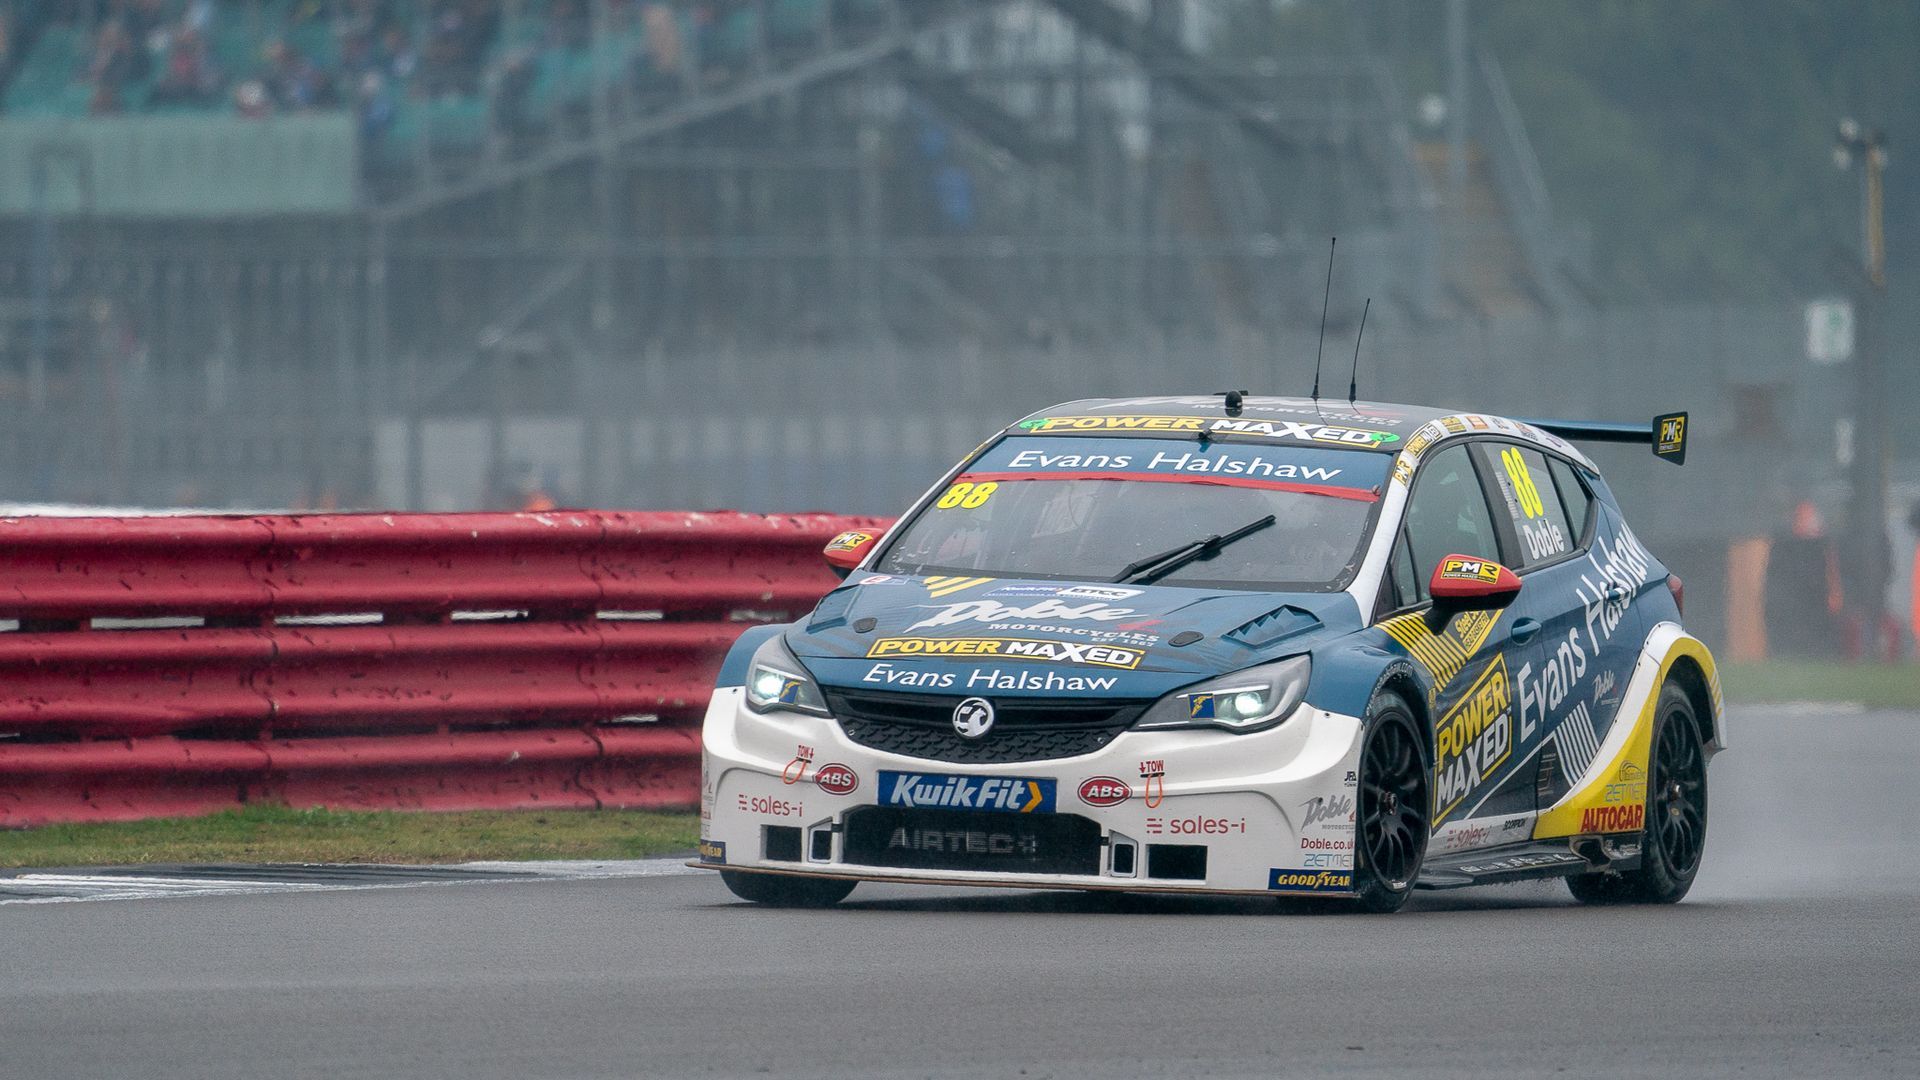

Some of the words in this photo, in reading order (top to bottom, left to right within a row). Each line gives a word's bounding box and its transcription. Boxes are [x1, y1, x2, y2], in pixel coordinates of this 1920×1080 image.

[1044, 416, 1205, 431] POWER
[1211, 419, 1374, 444] MAXED
[1661, 421, 1682, 441] PMR
[1008, 450, 1133, 469] Evans
[1147, 452, 1343, 481] Halshaw
[936, 482, 998, 509] 88
[1501, 447, 1544, 519] 88
[1523, 518, 1564, 560] Doble
[1446, 561, 1498, 576] PMR
[904, 600, 1149, 633] Doble
[988, 623, 1161, 642] MOTORCYCLES
[1517, 627, 1587, 743] Evans
[1575, 521, 1648, 656] Halshaw
[877, 641, 1001, 654] POWER
[1005, 642, 1135, 664] MAXED
[863, 664, 957, 687] Evans
[967, 669, 1118, 691] Halshaw
[1438, 671, 1508, 772] POWER
[1146, 760, 1164, 773] TOW
[1437, 713, 1508, 814] MAXED
[819, 772, 852, 787] ABS
[1087, 786, 1124, 799] ABS
[751, 796, 803, 817] sales-i
[1298, 794, 1353, 832] Doble
[1580, 805, 1643, 832] AUTOCAR
[1170, 815, 1246, 834] sales-i
[889, 827, 1014, 853] AIRTEC
[1278, 871, 1351, 888] GOODYEAR
